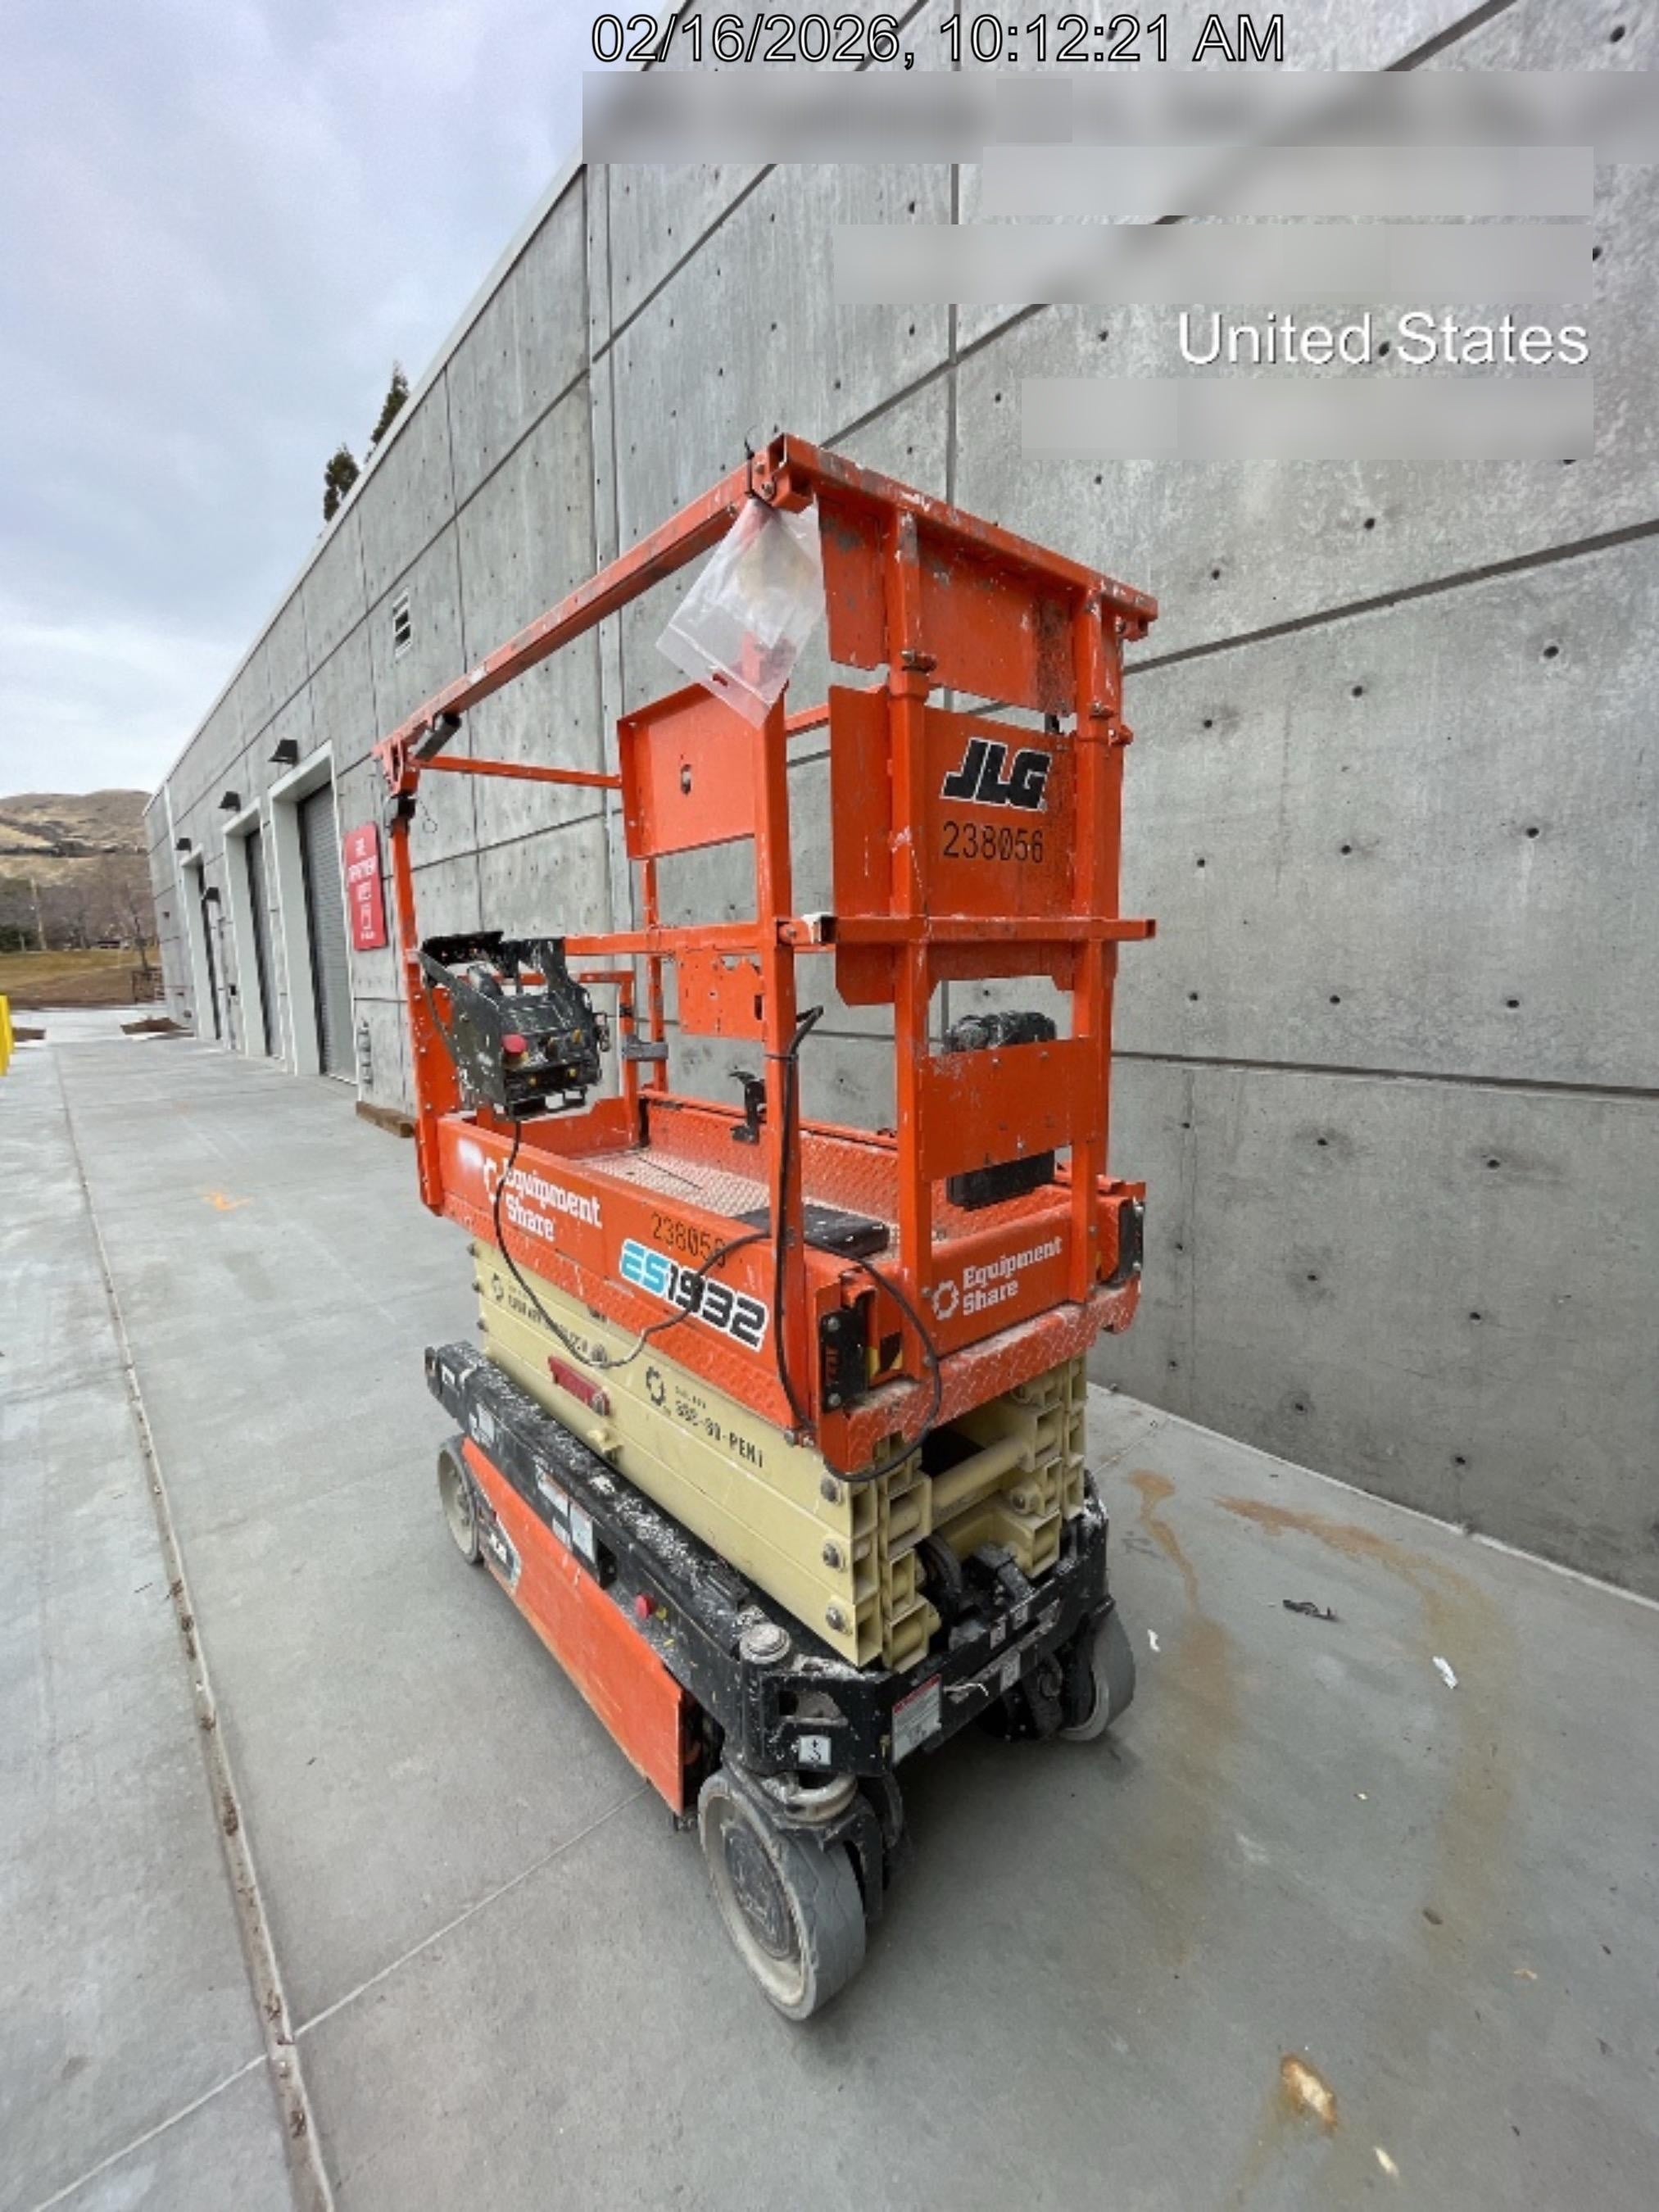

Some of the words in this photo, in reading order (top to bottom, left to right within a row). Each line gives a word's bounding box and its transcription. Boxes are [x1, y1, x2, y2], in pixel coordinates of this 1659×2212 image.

[940, 737, 1053, 812] JLG
[943, 820, 1043, 863] 238056
[505, 1193, 555, 1242] Share
[963, 1235, 1063, 1288] Equipment
[620, 1238, 769, 1353] ES1932
[963, 1280, 1019, 1316] Share
